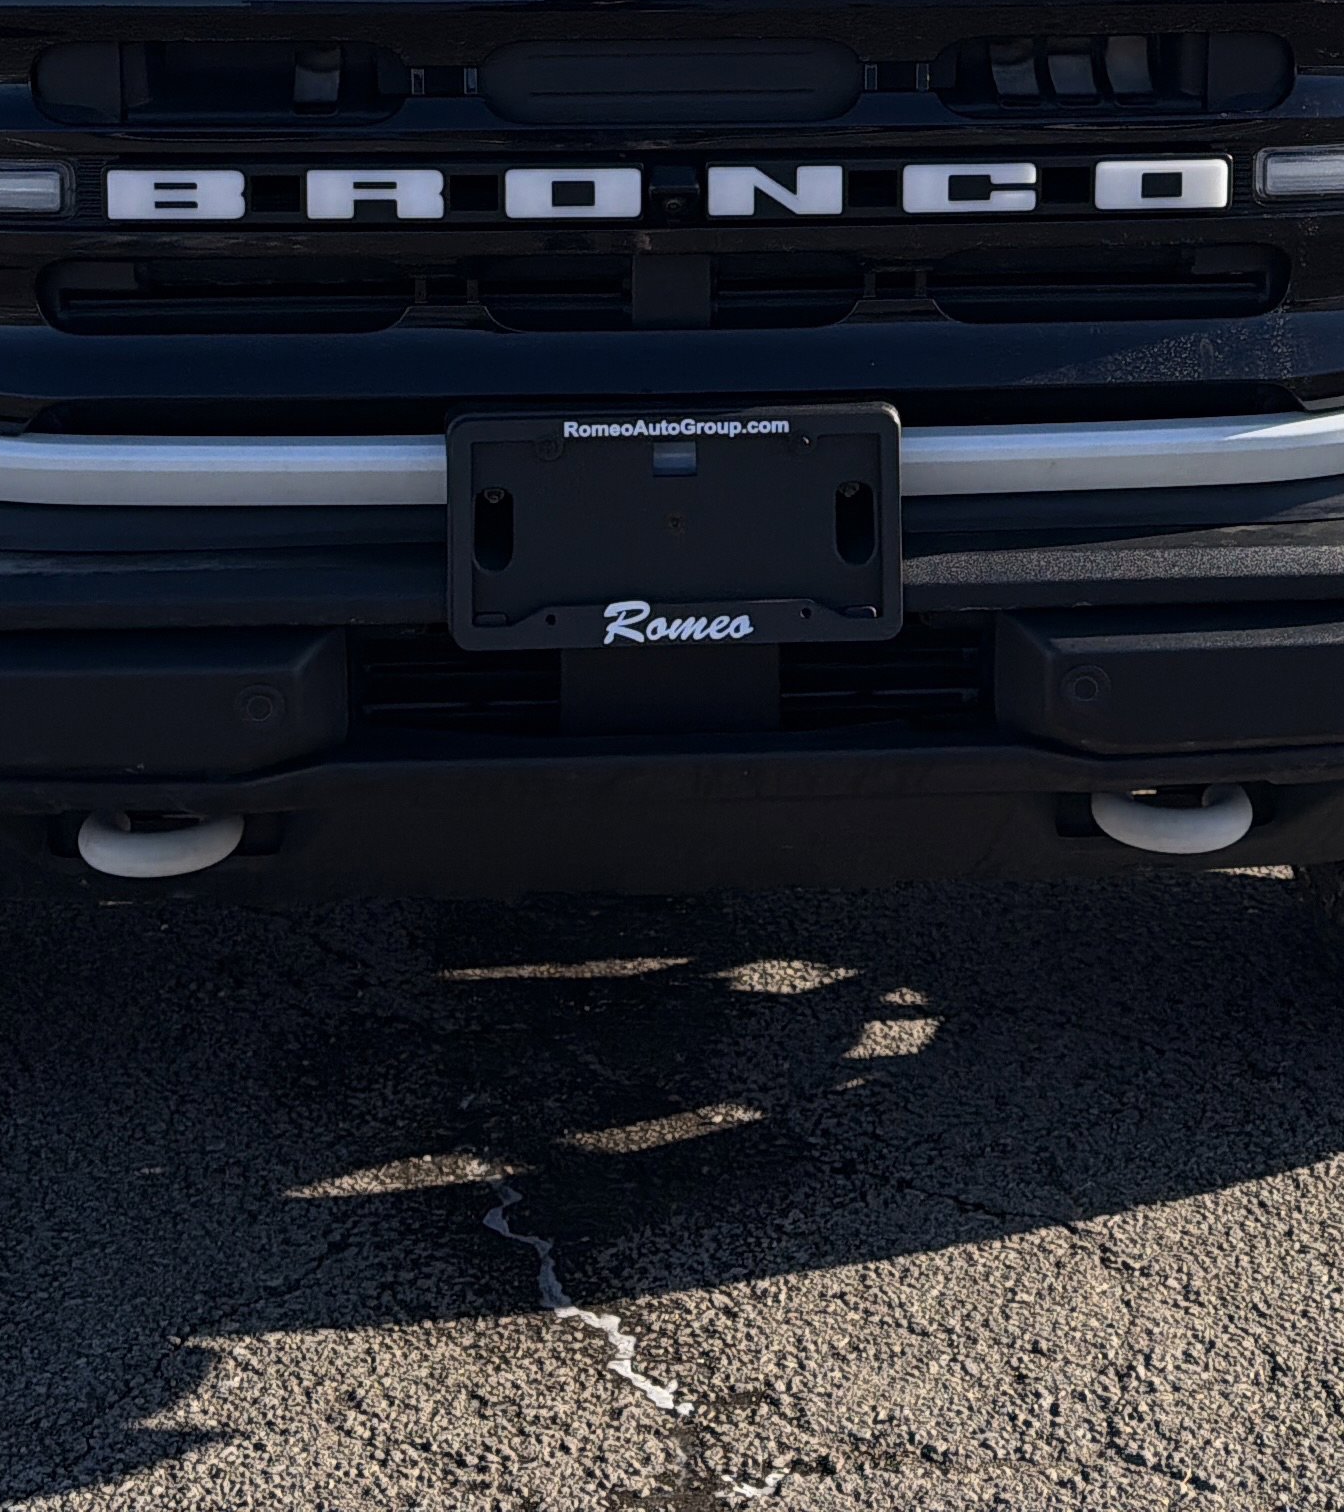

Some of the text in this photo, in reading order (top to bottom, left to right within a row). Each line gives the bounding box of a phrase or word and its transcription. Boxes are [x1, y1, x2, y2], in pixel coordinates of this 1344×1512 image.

[106, 159, 1229, 221] BRONCO
[563, 418, 790, 438] RomeoAutoGroup.com
[603, 600, 755, 645] Romeo
